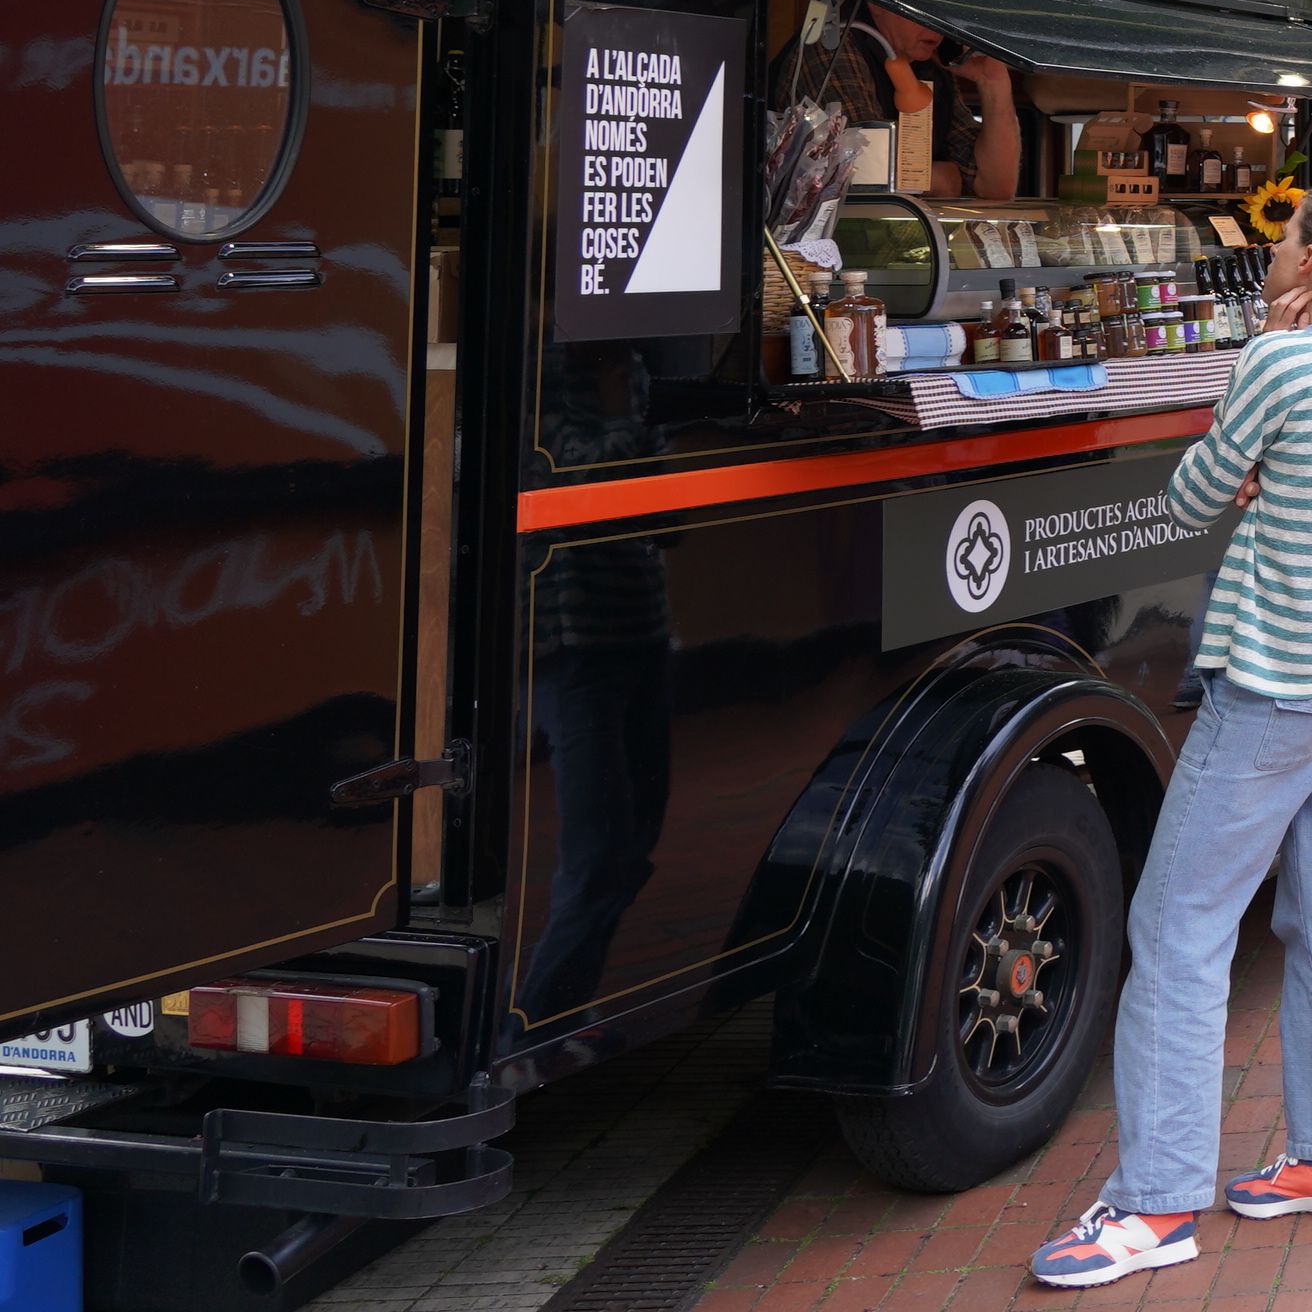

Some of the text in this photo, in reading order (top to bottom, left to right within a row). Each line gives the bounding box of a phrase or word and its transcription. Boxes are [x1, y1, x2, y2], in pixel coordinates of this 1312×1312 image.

[586, 48, 682, 87] A L'ALÇADA
[585, 83, 683, 120] D'ANDORRA
[584, 116, 648, 153] NOMÉS
[584, 155, 668, 188] ES PODEN
[583, 191, 653, 223] FER LES
[581, 227, 640, 259] COSES
[580, 258, 610, 295] BÉ.
[1024, 490, 1171, 543] PRODUCTES AGRÍC
[1024, 521, 1209, 573] I ARTESANS D'ANDO
[111, 1001, 152, 1029] AND
[2, 1046, 76, 1063] D'ANDORRA
